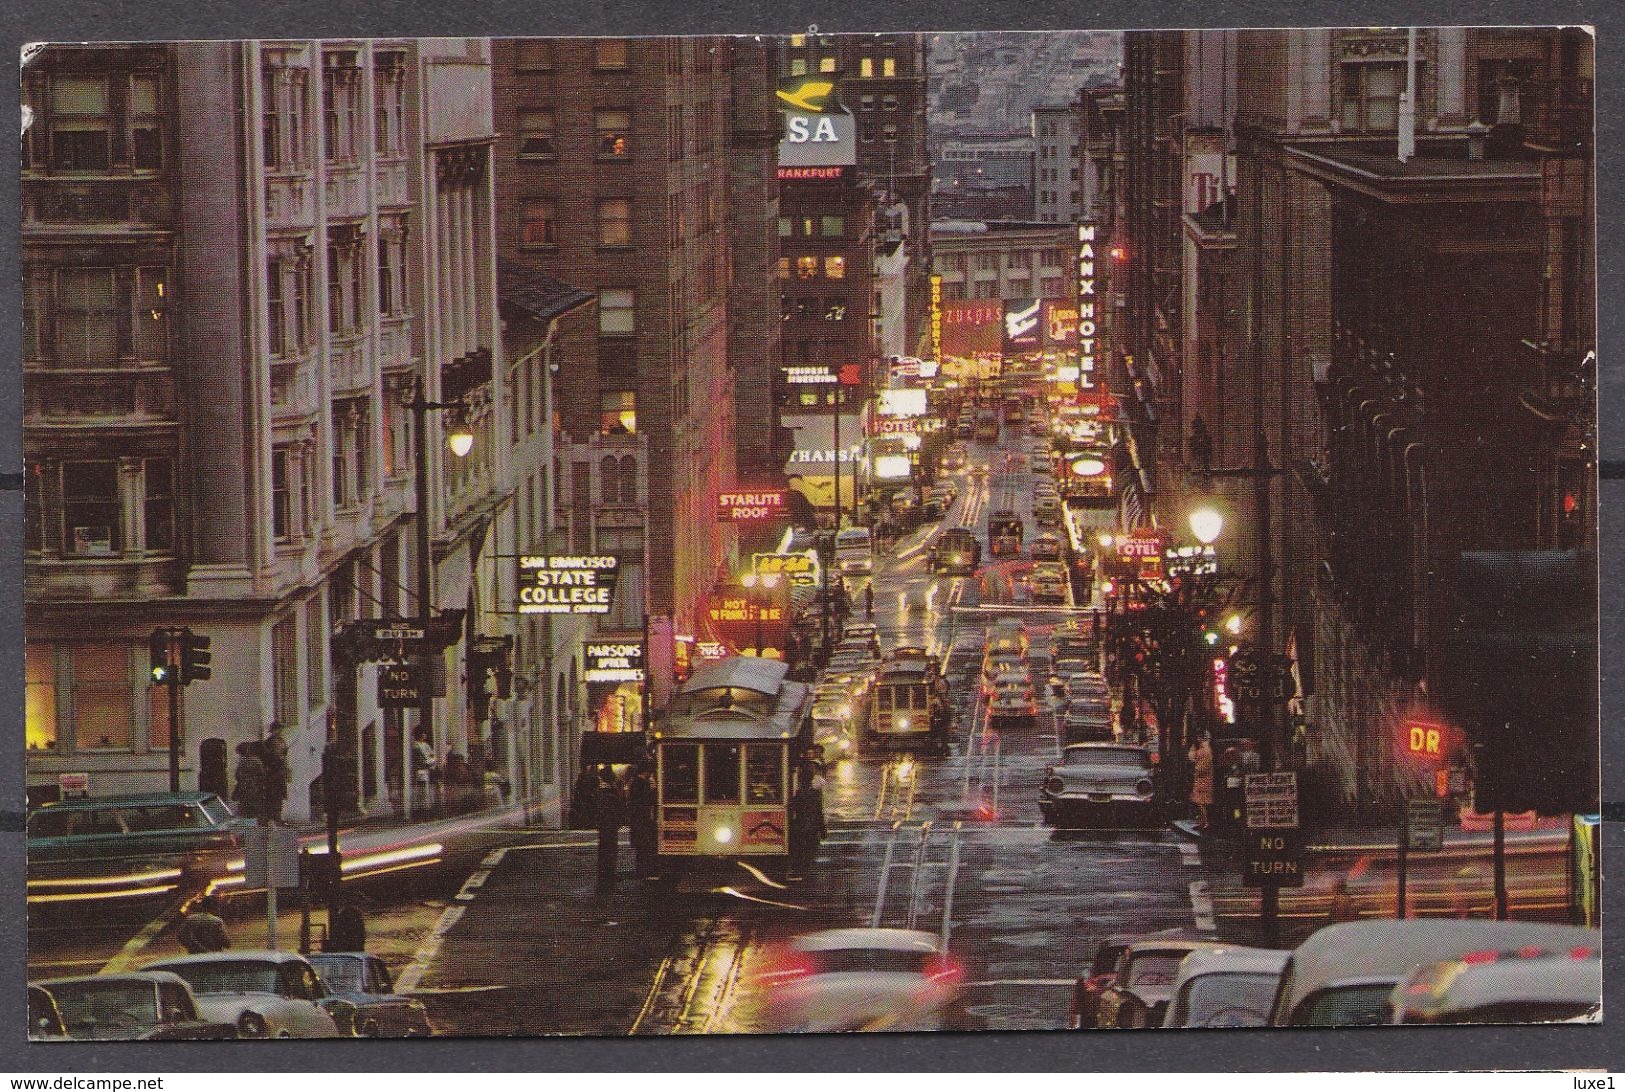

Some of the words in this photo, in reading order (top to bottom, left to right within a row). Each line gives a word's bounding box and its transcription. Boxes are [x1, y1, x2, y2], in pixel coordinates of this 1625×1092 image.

[789, 116, 839, 143] SA
[1079, 226, 1095, 296] MANX
[1079, 303, 1096, 389] HOTEL
[719, 494, 780, 506] STARLITE
[731, 507, 768, 518] ROOF
[520, 556, 545, 569] SAN
[537, 570, 596, 585] STATE
[520, 587, 610, 603] COLLEGE
[383, 688, 418, 699] TURN
[1410, 727, 1440, 752] DR
[1260, 838, 1285, 850] NO
[1252, 861, 1297, 874] TURN
